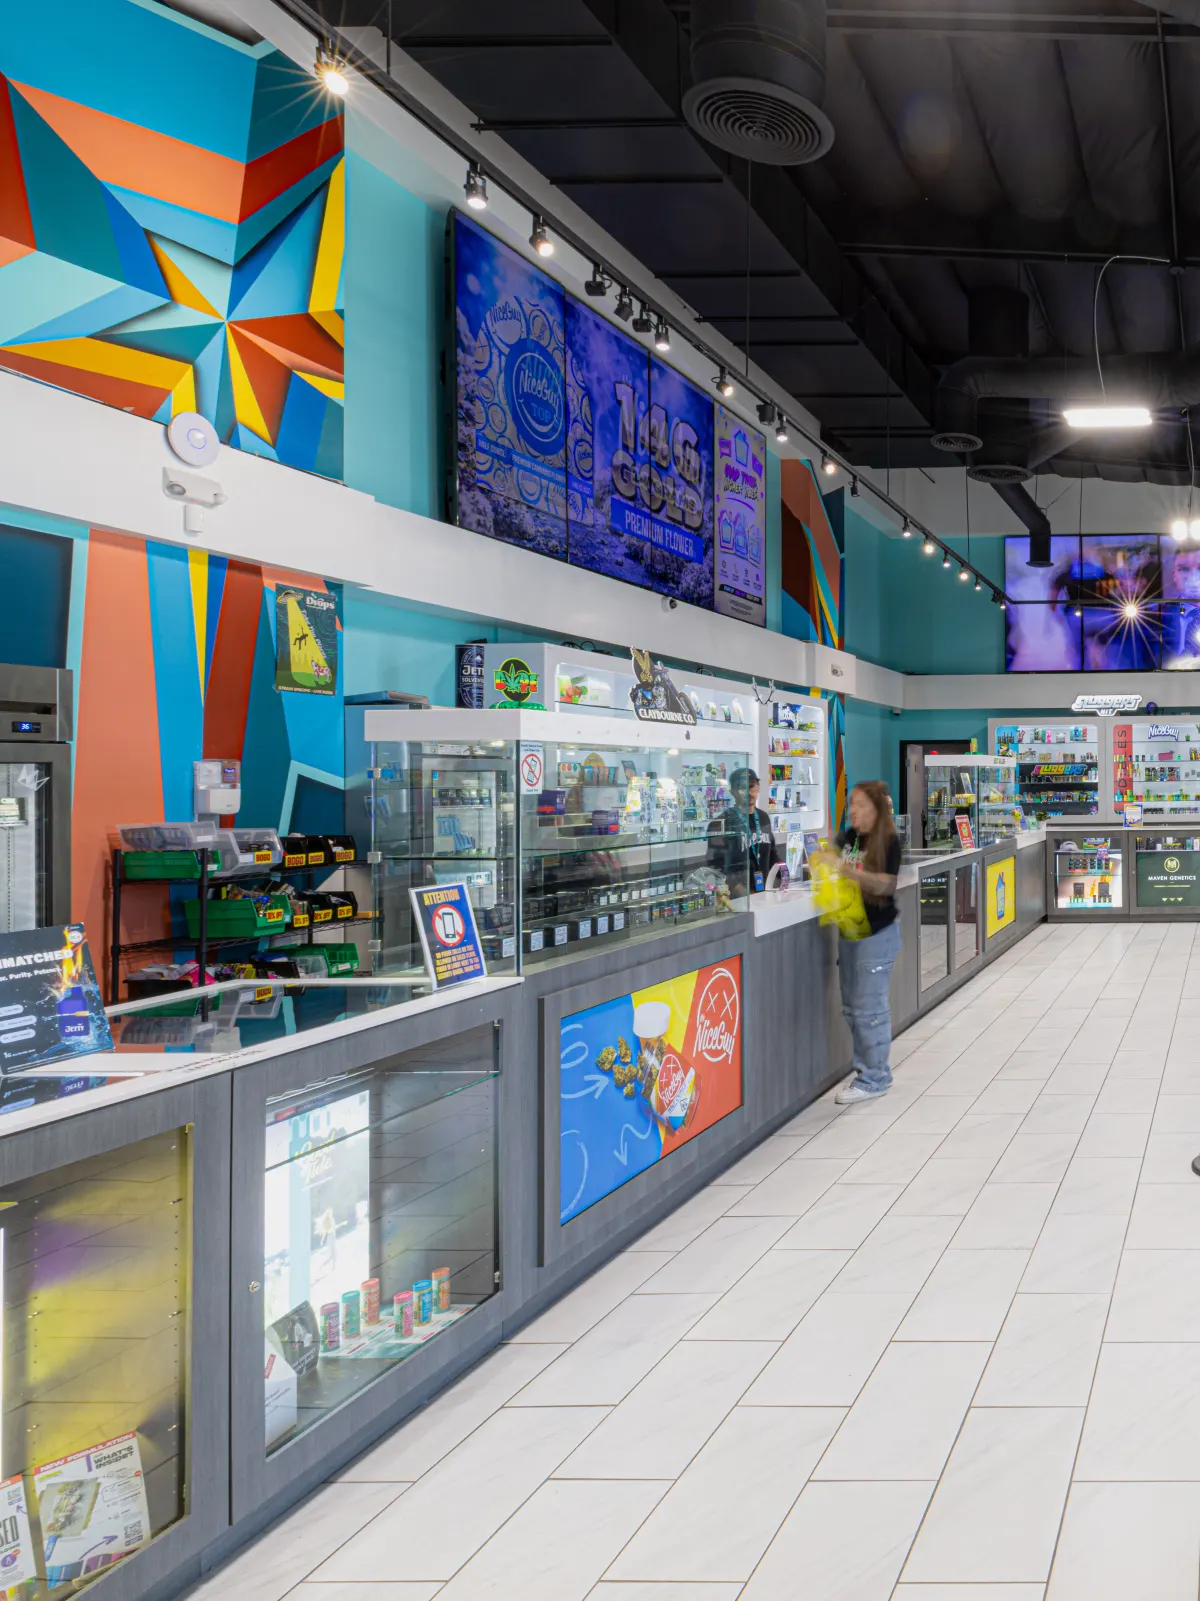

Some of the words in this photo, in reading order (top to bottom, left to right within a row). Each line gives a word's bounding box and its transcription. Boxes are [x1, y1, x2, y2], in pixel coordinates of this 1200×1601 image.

[519, 369, 560, 417] NiceGuy
[612, 450, 704, 532] GOLD
[625, 509, 663, 547] PREMIUM
[665, 526, 694, 557] FLOWER
[306, 596, 335, 610] Drops
[639, 708, 683, 723] CLAYBOURNE
[683, 714, 696, 723] CO.
[1148, 723, 1179, 741] NiceGuy
[287, 856, 304, 866] BOGO
[336, 850, 353, 860] BOGO
[423, 888, 460, 906] ATTENTION
[9, 971, 33, 981] Purity.
[34, 967, 62, 976] Potency.
[693, 1020, 736, 1065] NiceGuy
[40, 1459, 65, 1472] NEW
[67, 1433, 133, 1463] FORMULATION
[93, 1445, 134, 1465] WHAT'S
[95, 1451, 134, 1470] INSIDE?
